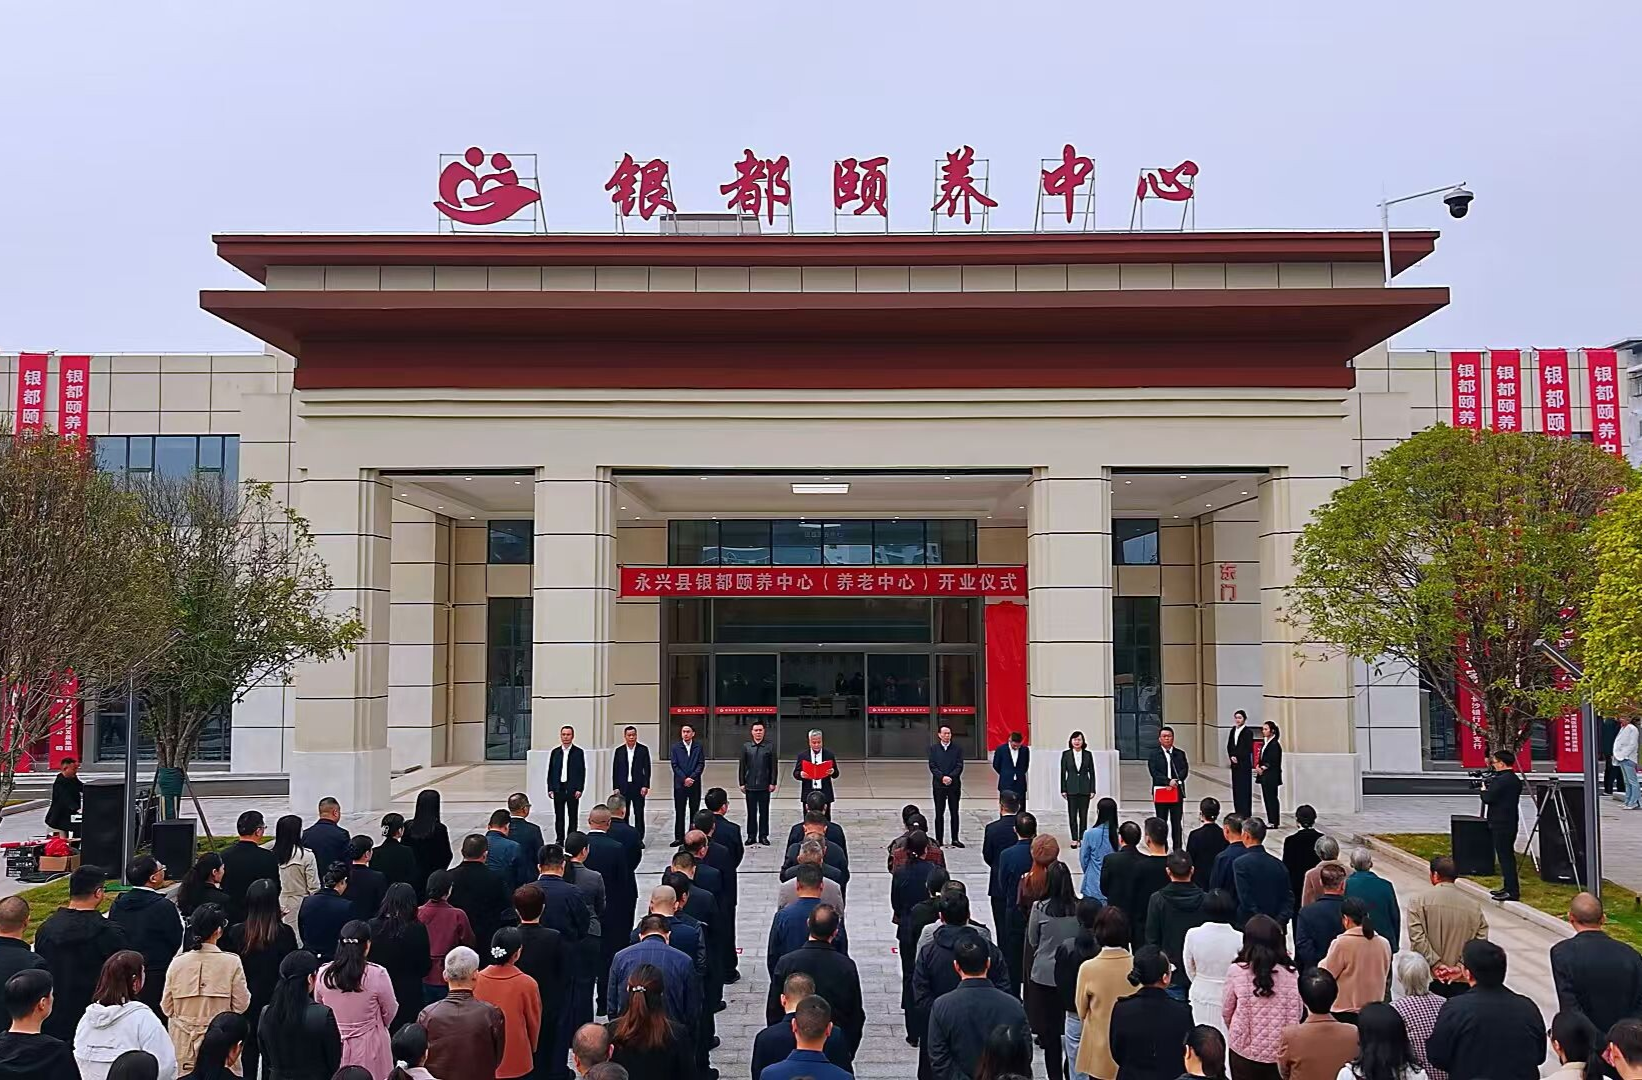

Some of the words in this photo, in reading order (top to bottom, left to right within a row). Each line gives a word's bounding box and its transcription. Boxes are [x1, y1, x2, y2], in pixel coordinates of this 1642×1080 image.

[604, 145, 1199, 226] 银都颐养中心
[1457, 363, 1476, 425] 银都颐养
[1496, 365, 1516, 430] 银都颐养
[1544, 365, 1566, 432] 银都颐
[1220, 563, 1237, 601] 东门
